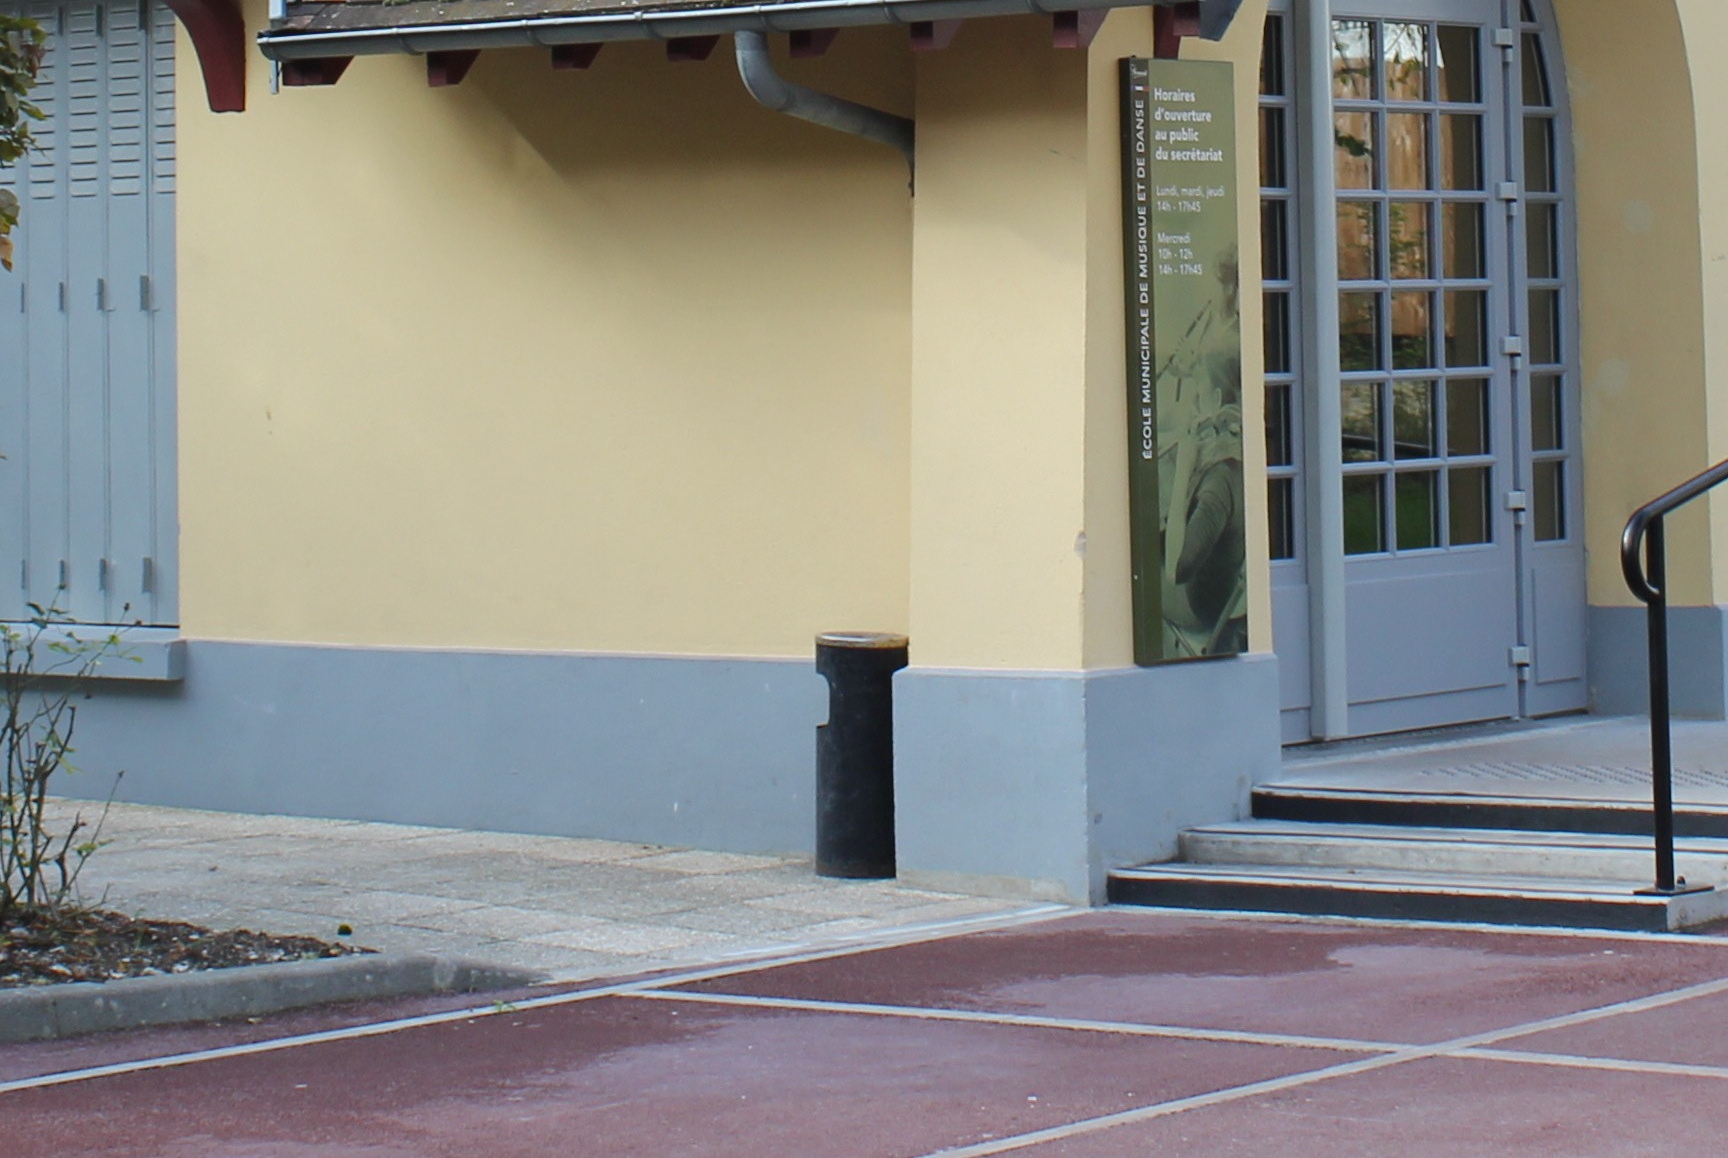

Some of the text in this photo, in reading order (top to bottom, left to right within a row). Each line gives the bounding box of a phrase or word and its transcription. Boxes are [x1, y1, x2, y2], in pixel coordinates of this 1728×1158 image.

[1154, 88, 1195, 102] Horaires
[1154, 107, 1211, 122] d'ouverture
[1155, 127, 1199, 144] au public
[1155, 146, 1223, 162] du secrétariat
[1156, 185, 1225, 199] Lundi, mardi, jeudi
[1157, 201, 1171, 211] 14h
[1178, 201, 1201, 212] 17h45
[1157, 233, 1191, 244] Mercredi
[1158, 248, 1172, 259] 10h
[1179, 248, 1193, 259] 12h
[1159, 264, 1172, 275] 14h
[1179, 264, 1203, 275] 17h45
[1135, 100, 1152, 459] ÉCOLE MUNICIPALE DE MUSIQUE ET DE DANSE
